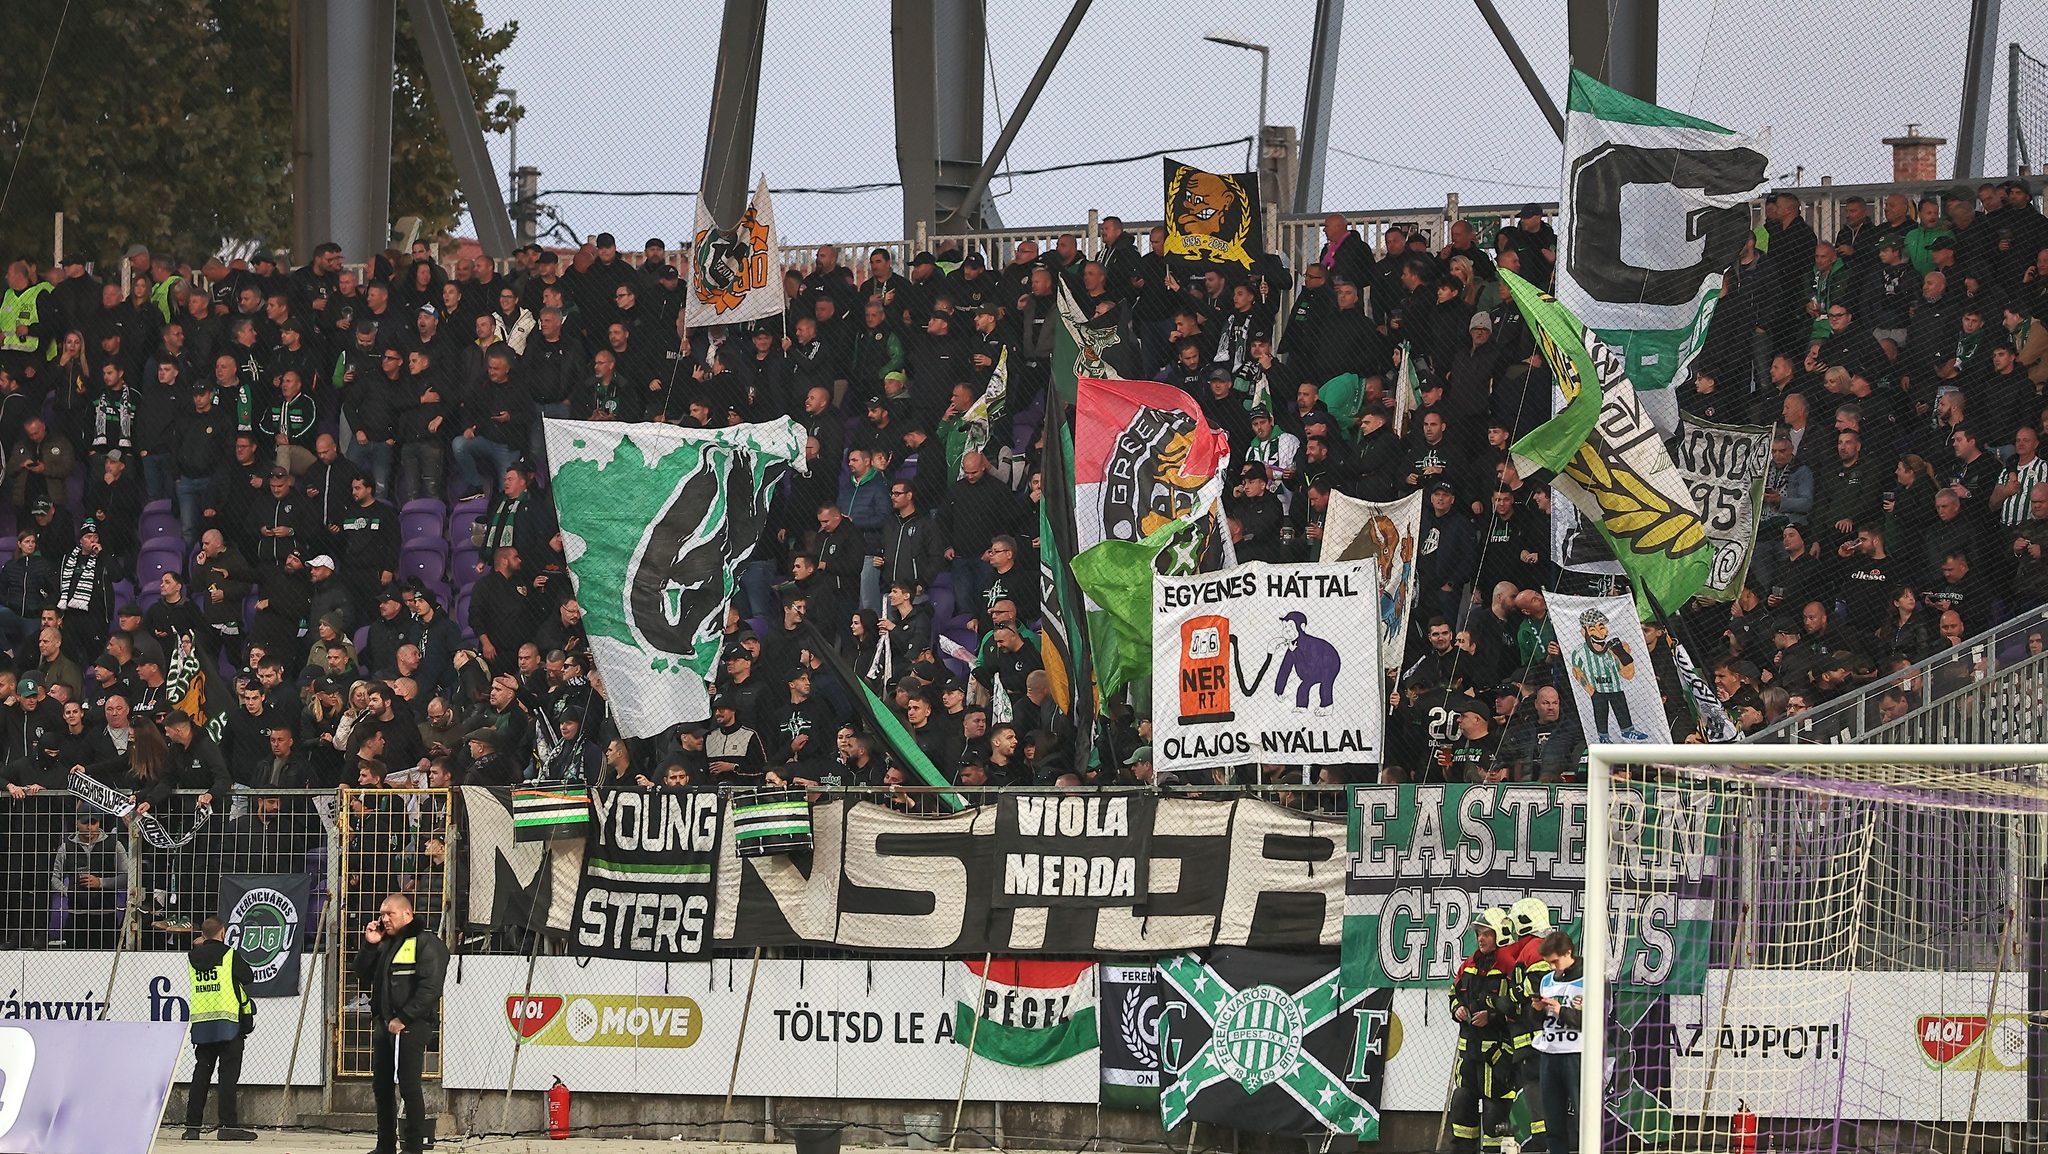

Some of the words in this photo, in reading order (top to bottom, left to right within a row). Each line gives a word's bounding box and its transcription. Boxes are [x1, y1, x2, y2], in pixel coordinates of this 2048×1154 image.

[1182, 236, 1201, 248] 1995
[1111, 409, 1165, 504] GREE
[1670, 429, 1751, 480] NNO
[1684, 480, 1742, 531] 95
[1851, 570, 1886, 582] ellesse
[1183, 665, 1226, 693] NER
[1199, 692, 1218, 710] RT.
[1163, 732, 1251, 760] OLAJOS
[1261, 727, 1373, 754] NYÁLLAL
[590, 787, 718, 852] YOUNG
[1016, 796, 1129, 837] VIOLA
[1352, 784, 1716, 885] EASTERN
[1004, 854, 1136, 898] MERDA
[236, 891, 294, 918] FERENCVÁROS
[579, 887, 709, 954] STERS
[1377, 887, 1679, 986] GRNS
[253, 963, 278, 980] ATICS
[512, 1000, 544, 1019] MOL
[601, 1006, 691, 1037] MOVE
[773, 1001, 883, 1044] TÖLTSD
[894, 1012, 925, 1044] LE
[1274, 991, 1299, 1030] TORNA
[1720, 1023, 1840, 1060] APPOT!
[1924, 1020, 1966, 1042] MOL
[1279, 1035, 1299, 1070] CLUB
[1136, 1074, 1153, 1085] ON
[1233, 1068, 1244, 1079] 18
[1263, 1070, 1276, 1080] 99
